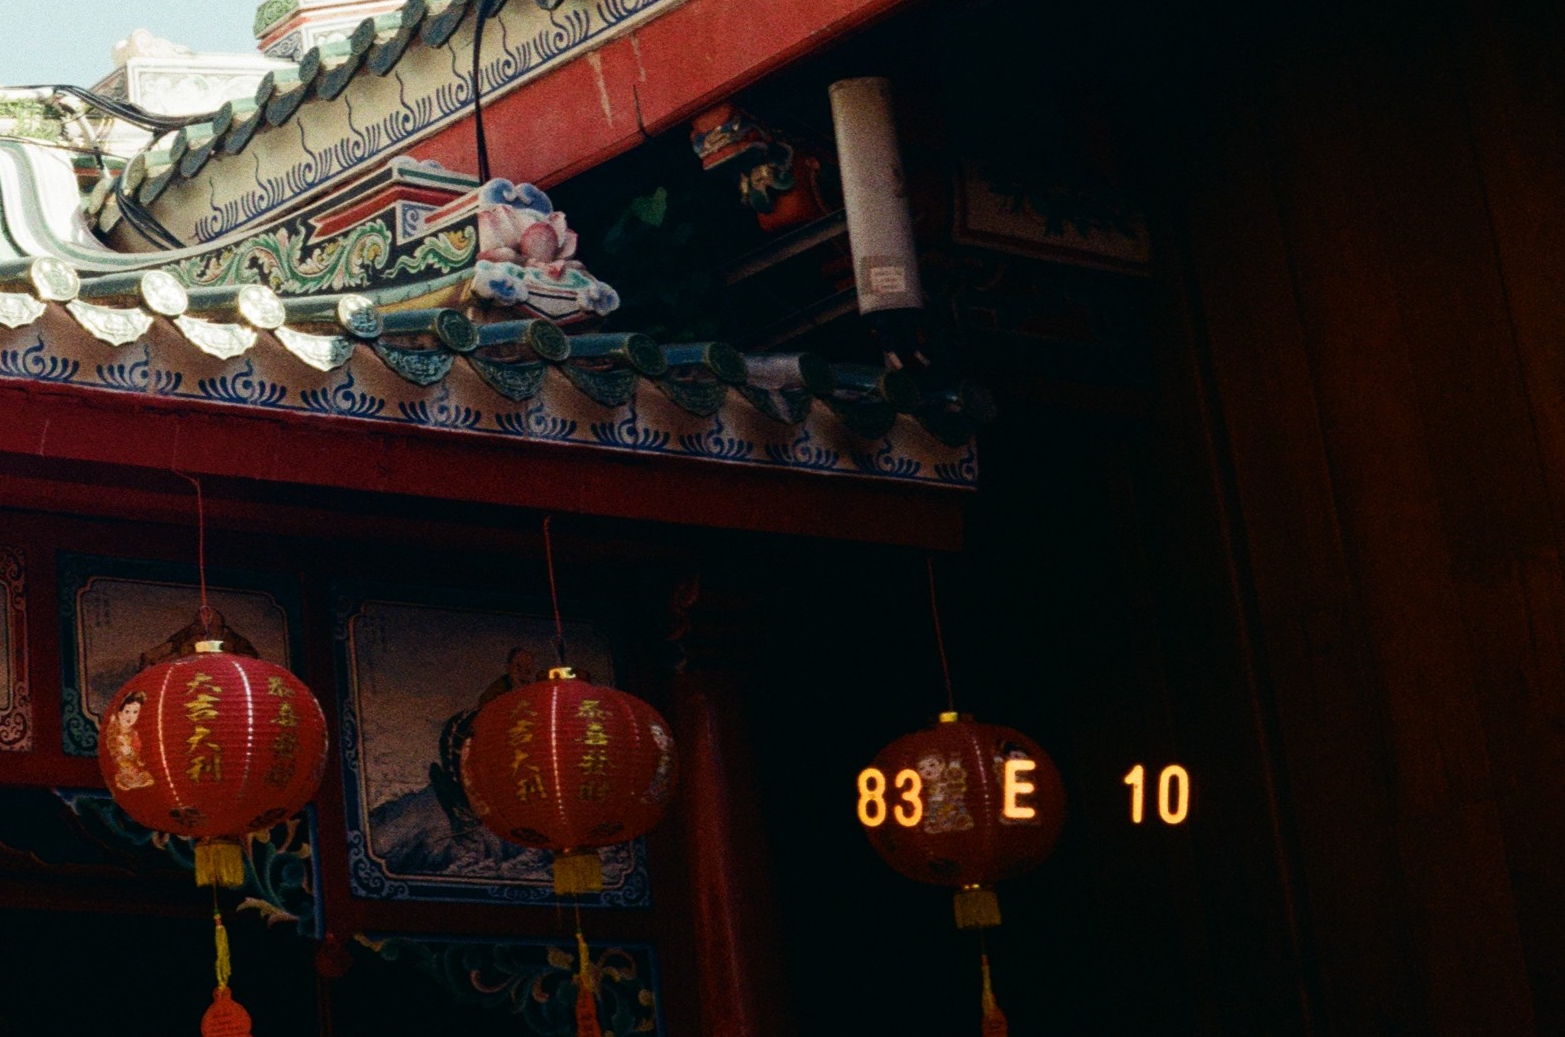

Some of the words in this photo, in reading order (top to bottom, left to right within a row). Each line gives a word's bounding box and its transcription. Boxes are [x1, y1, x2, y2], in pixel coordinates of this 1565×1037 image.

[184, 672, 224, 784] 大吉大利
[507, 699, 549, 804] 大吉大利
